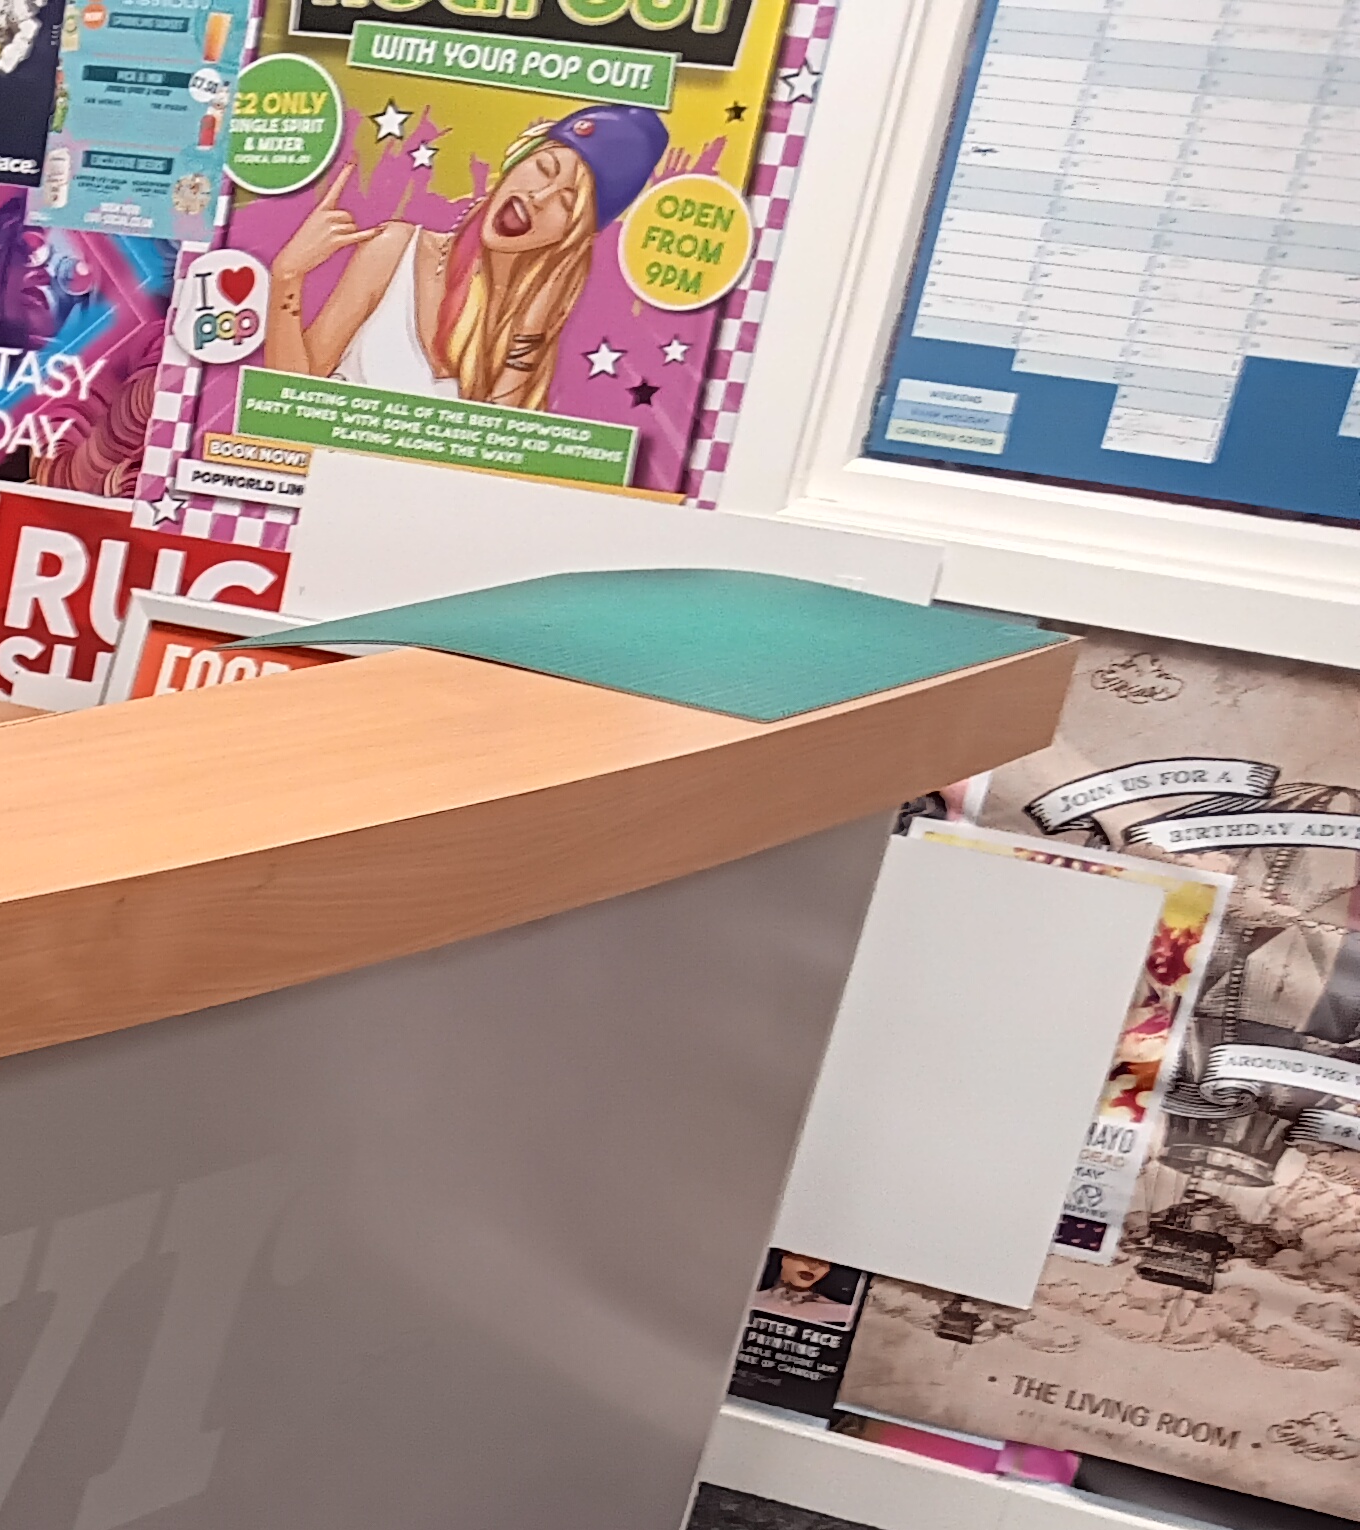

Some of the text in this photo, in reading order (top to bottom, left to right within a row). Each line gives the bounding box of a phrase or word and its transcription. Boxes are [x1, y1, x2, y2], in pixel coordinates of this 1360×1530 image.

[371, 33, 654, 91] WITH YOUR POP OUT!
[262, 91, 328, 115] ONLY
[229, 118, 326, 133] SINGLE SPIRIT
[257, 137, 305, 151] MIXER
[657, 195, 735, 232] OPEN
[641, 225, 724, 265] FROM
[194, 272, 215, 311] I
[645, 261, 703, 295] 9PM
[193, 308, 260, 350] pop
[246, 398, 625, 463] PARTY TUNES WITH SOME CLASSIC EMO KID ANTHEMS
[280, 387, 592, 442] BLASTING OUT ALL OF THE BEST POPWORLD
[209, 440, 309, 468] BOOK NOW!
[331, 426, 392, 445] PLAYING
[394, 436, 445, 453] ALONG
[449, 443, 477, 458] THE
[191, 470, 275, 492] POPWORLD
[1060, 770, 1232, 813] JOIN US FOR A
[1170, 822, 1294, 843] BIRTHDAY
[1228, 1056, 1349, 1082] AROUND THE
[747, 1331, 821, 1357] PAINTING
[801, 1329, 842, 1348] FACE
[1012, 1374, 1061, 1405] THE
[1065, 1389, 1150, 1427] LIVING
[1156, 1412, 1242, 1450] ROOM
